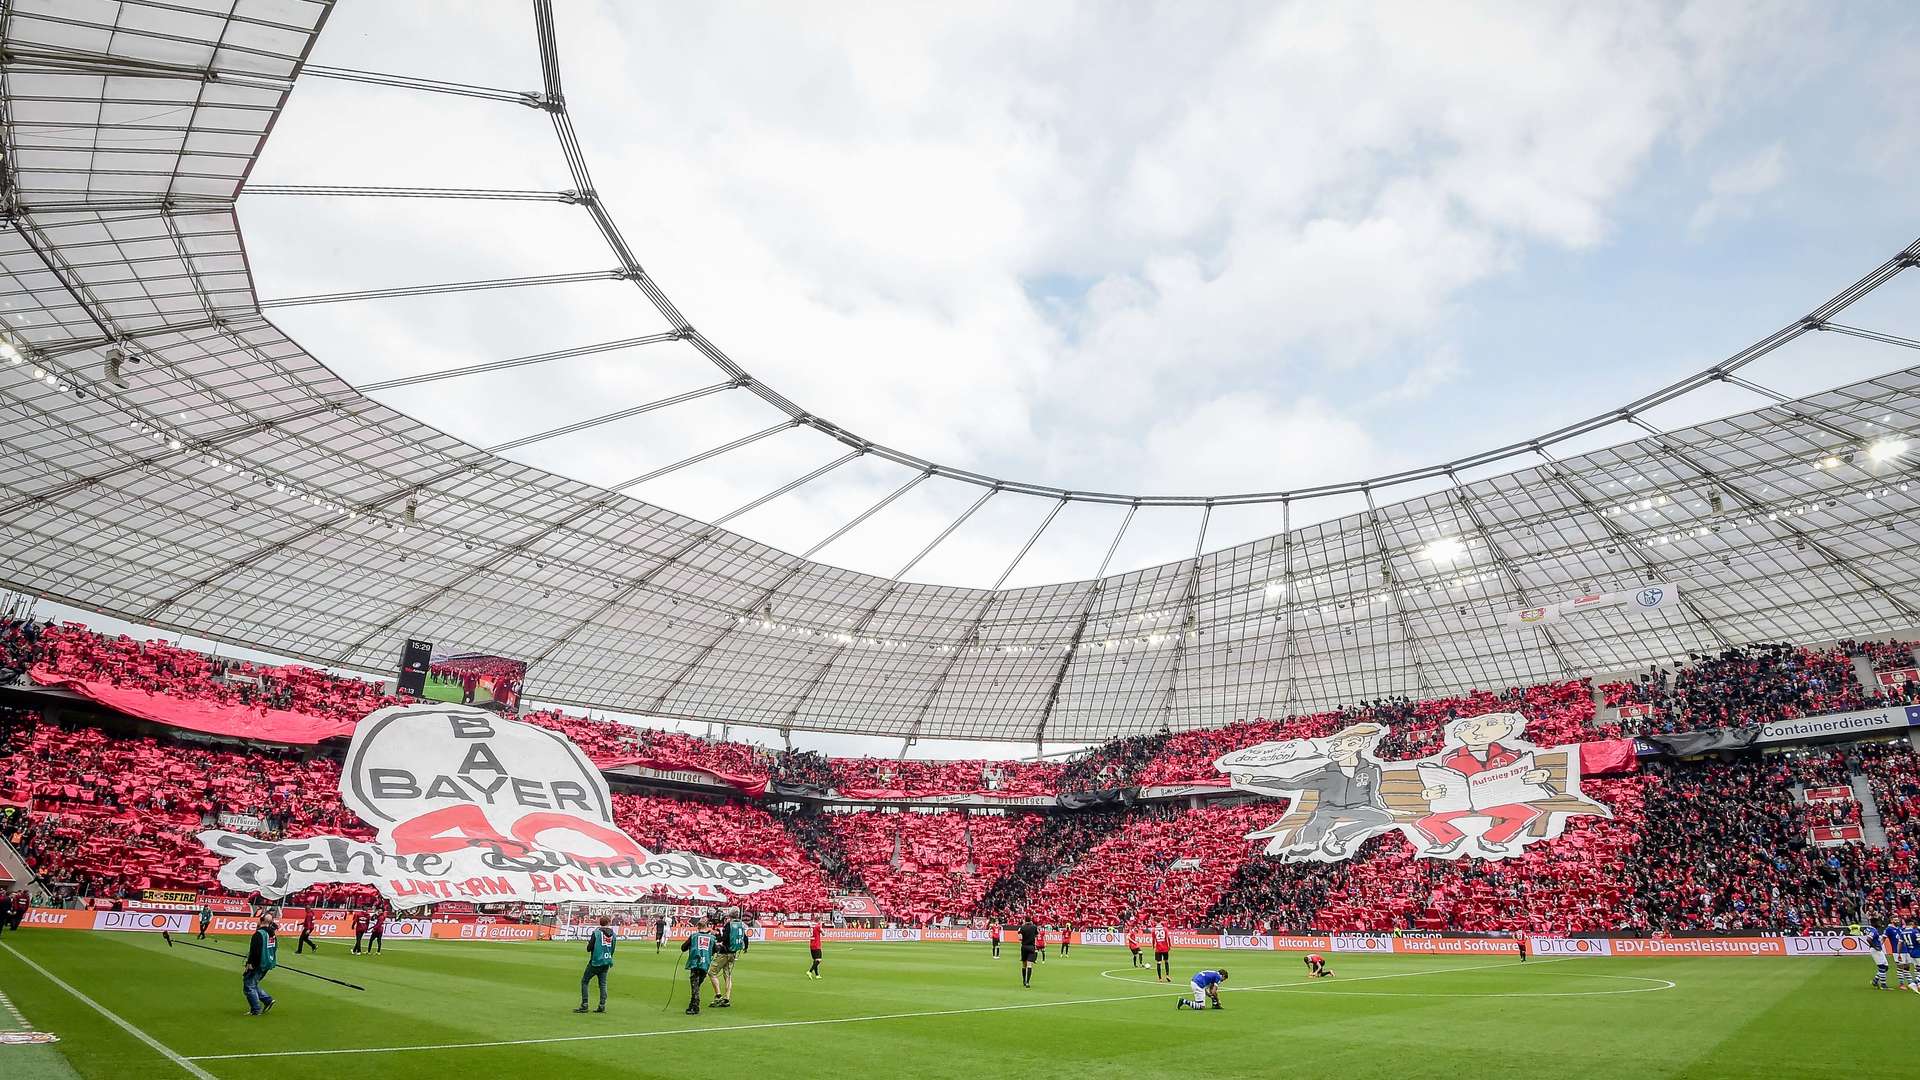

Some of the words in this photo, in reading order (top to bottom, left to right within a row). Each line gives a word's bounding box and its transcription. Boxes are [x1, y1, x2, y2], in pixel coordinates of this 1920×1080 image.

[411, 641, 431, 651] 15:29
[1763, 713, 1890, 738] Containerdienst
[1472, 772, 1509, 787] Aufstieg
[1510, 764, 1529, 777] 1979
[369, 768, 592, 811] BAYER
[217, 835, 452, 888] Jahre
[390, 876, 516, 898] UNTERM
[105, 912, 183, 928] DITCON
[489, 926, 533, 938] @ditcon
[1155, 930, 1166, 939] 29
[1173, 937, 1219, 948] Betreuung
[1224, 936, 1269, 947] DITCON
[1279, 937, 1325, 949] ditcon.de
[1336, 937, 1387, 949] DITCON
[1439, 941, 1465, 951] und
[1469, 940, 1519, 951] Software
[1539, 939, 1602, 952] DITCON
[1615, 940, 1779, 954] EDV-Dienstleistungen
